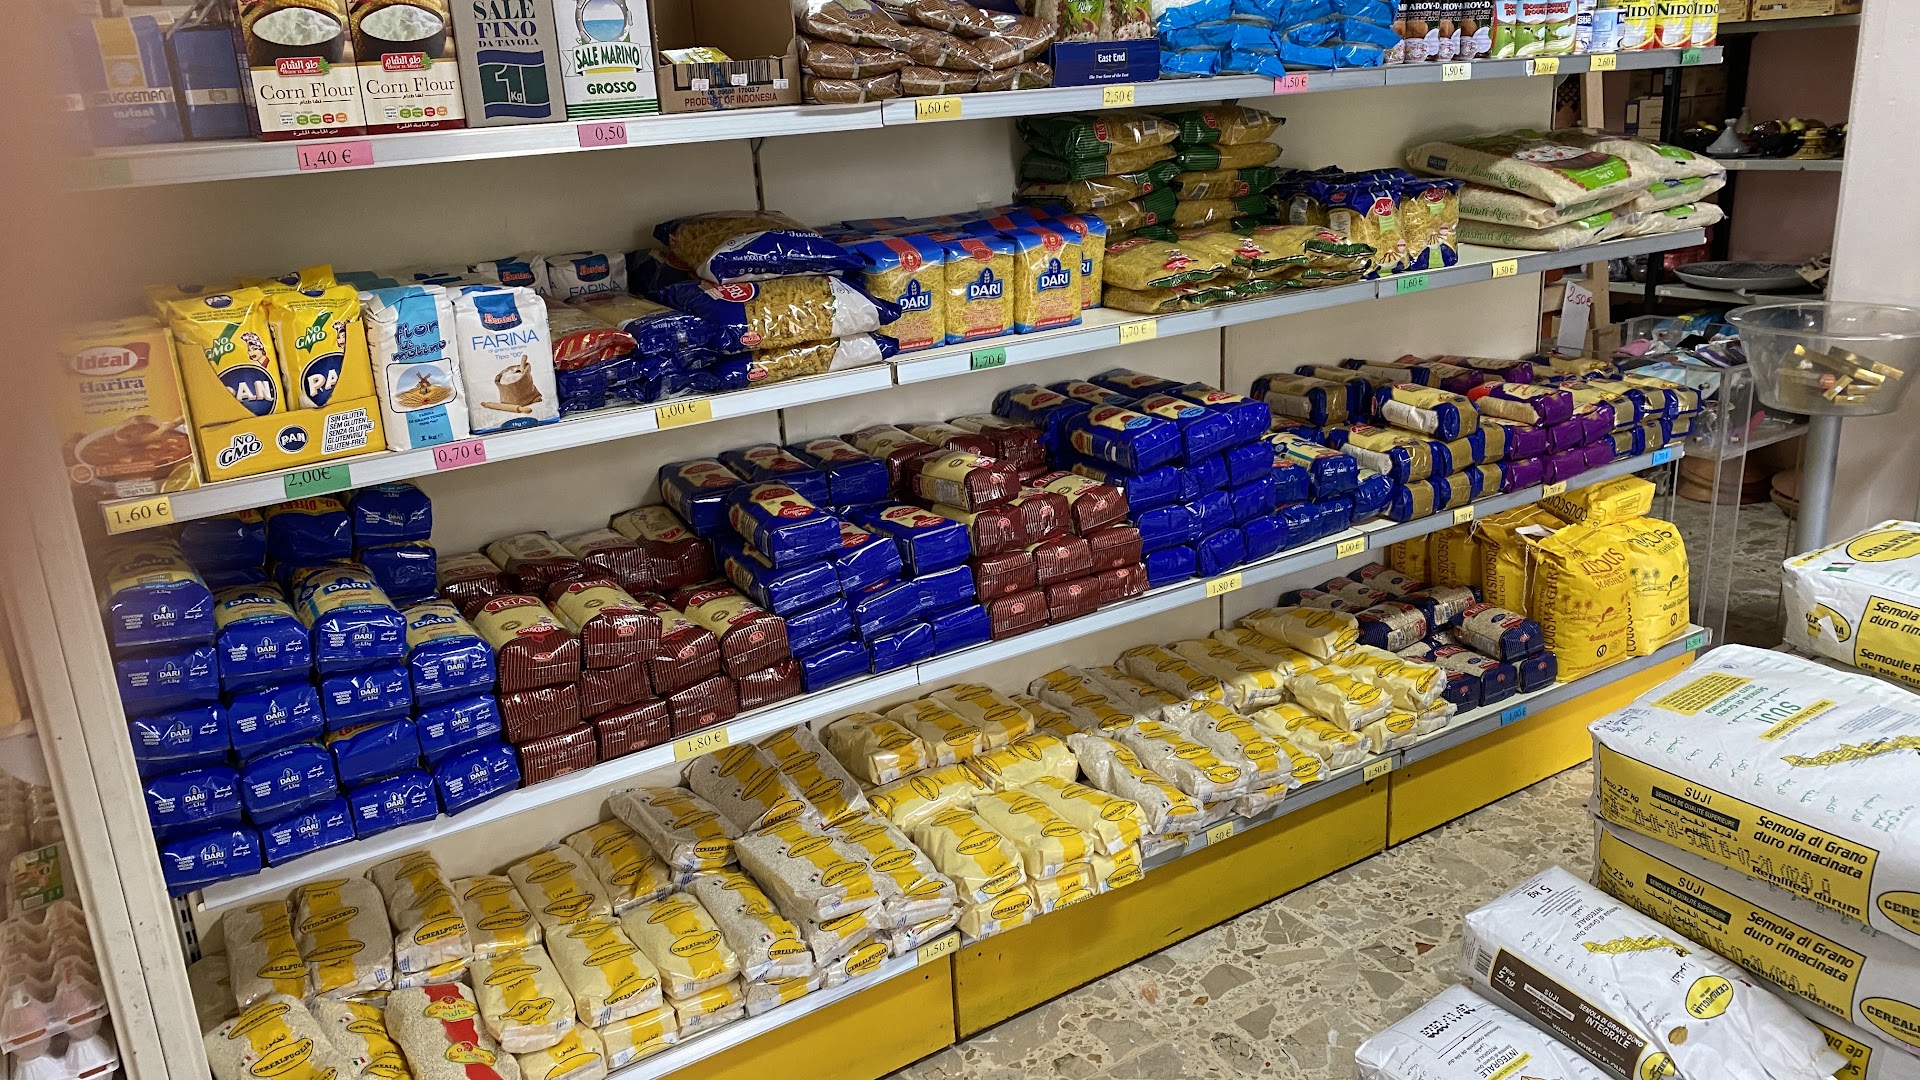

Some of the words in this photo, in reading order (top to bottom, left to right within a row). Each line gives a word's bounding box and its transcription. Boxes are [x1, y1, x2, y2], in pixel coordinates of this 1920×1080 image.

[473, 0, 536, 20] SALE
[1657, 3, 1694, 16] NIDO
[478, 21, 538, 38] FINO
[478, 40, 493, 48] DA
[493, 38, 540, 48] TAVOLA
[575, 49, 599, 69] SALE
[601, 45, 640, 66] MARINO
[1097, 53, 1112, 63] East
[1113, 52, 1126, 62] End
[1611, 57, 1615, 66] €
[1443, 65, 1458, 77] 1,90
[1459, 65, 1465, 75] €
[366, 79, 409, 95] Corn
[412, 77, 455, 92] Flour
[587, 81, 637, 94] GROSSO
[1283, 76, 1300, 88] 1,50
[1301, 76, 1307, 86] €
[260, 85, 305, 101] Corn
[310, 82, 355, 98] Flour
[510, 87, 523, 102] Kg
[724, 95, 736, 104] OF
[737, 93, 778, 103] INDONESIA
[1104, 90, 1125, 104] 2,50
[1125, 90, 1133, 102] €
[918, 101, 941, 116] 1,60
[943, 100, 951, 113] €
[595, 125, 625, 142] 0,50
[303, 149, 337, 167] 1,40
[342, 149, 353, 164] €
[1505, 174, 1524, 189] Rice
[1490, 207, 1511, 220] Rice
[1495, 264, 1509, 275] 1,50
[1509, 264, 1514, 273] €
[1041, 272, 1069, 287] DARI
[1402, 277, 1418, 290] 1,60
[1417, 277, 1423, 287] €
[970, 283, 1001, 298] DARI
[901, 297, 930, 310] DARI
[306, 325, 322, 336] NO
[1121, 326, 1140, 340] 1,70
[1140, 325, 1147, 336] €
[214, 336, 229, 346] NO
[296, 330, 326, 349] GMO
[471, 329, 540, 351] FARINA
[391, 340, 447, 362] molino
[974, 354, 995, 369] 1,70
[997, 353, 1004, 365] €
[331, 414, 342, 424] SIN
[342, 410, 365, 421] GLUTEN
[660, 402, 685, 419] 1,00
[688, 401, 697, 413] €
[328, 428, 348, 438] SENZA
[348, 422, 373, 434] GLUTINE
[330, 421, 343, 430] SEM
[343, 417, 366, 428] GLUTEN
[234, 434, 254, 446] NO
[281, 432, 306, 446] PAN
[326, 437, 366, 451] GLUTEN-FREE
[427, 433, 438, 441] kg
[221, 441, 263, 465] GMO
[438, 445, 470, 463] 0,70
[474, 444, 484, 456] €
[114, 505, 151, 525] 1,60
[156, 502, 169, 516] €
[1339, 544, 1354, 555] 2,00
[1354, 541, 1360, 551] €
[327, 582, 368, 592] DARI
[1212, 581, 1229, 594] 1,80
[1229, 579, 1236, 589] €
[153, 612, 175, 621] DARI
[1873, 602, 1920, 622] Semola
[413, 618, 452, 628] DARI
[1869, 615, 1899, 630] duro
[354, 633, 373, 641] DARI
[256, 644, 277, 653] DARI
[446, 662, 465, 671] DARI
[1860, 648, 1911, 671] Semoule
[1860, 662, 1876, 671] de
[159, 670, 180, 679] DARI
[360, 687, 378, 696] DARI
[1755, 701, 1802, 725] SUJI
[687, 737, 711, 752] 1,80
[715, 731, 722, 743] €
[1368, 766, 1383, 777] 1,50
[1383, 762, 1388, 771] €
[1617, 785, 1629, 797] 25
[1630, 793, 1640, 804] kg
[1655, 790, 1677, 806] SEMOULE
[1684, 787, 1712, 805] SUJI
[1209, 830, 1225, 845] 1,50
[1226, 829, 1232, 838] €
[1756, 815, 1806, 842] Semola
[1808, 832, 1823, 847] di
[1825, 841, 1868, 865] Grano
[1753, 831, 1785, 850] duro
[1787, 845, 1864, 880] rimacinata
[1613, 868, 1624, 881] 25
[1625, 877, 1635, 889] kg
[1527, 890, 1542, 899] kg
[1677, 877, 1705, 897] SUJI
[1752, 864, 1810, 895] Remilled
[1814, 889, 1861, 916] durum
[925, 941, 946, 957] 1,50
[947, 937, 954, 949] €
[1746, 911, 1795, 941] Semola
[1796, 933, 1811, 948] di
[1814, 941, 1855, 969] Grano
[1743, 925, 1774, 946] duro
[1776, 941, 1849, 982] rimacinata
[1498, 970, 1505, 980] 5
[1505, 976, 1517, 987] kg
[1543, 988, 1560, 1003] SUJI
[436, 1002, 469, 1010] DALIAH
[1578, 1003, 1602, 1021] SEMOLA
[1607, 1017, 1628, 1036] GRANO
[1626, 1031, 1644, 1049] DURO
[1585, 1016, 1633, 1050] INTEGRALE
[1551, 1022, 1576, 1042] WHOLE
[1576, 1039, 1602, 1058] WHEAT
[254, 1041, 312, 1074] CEREALPUGLIA
